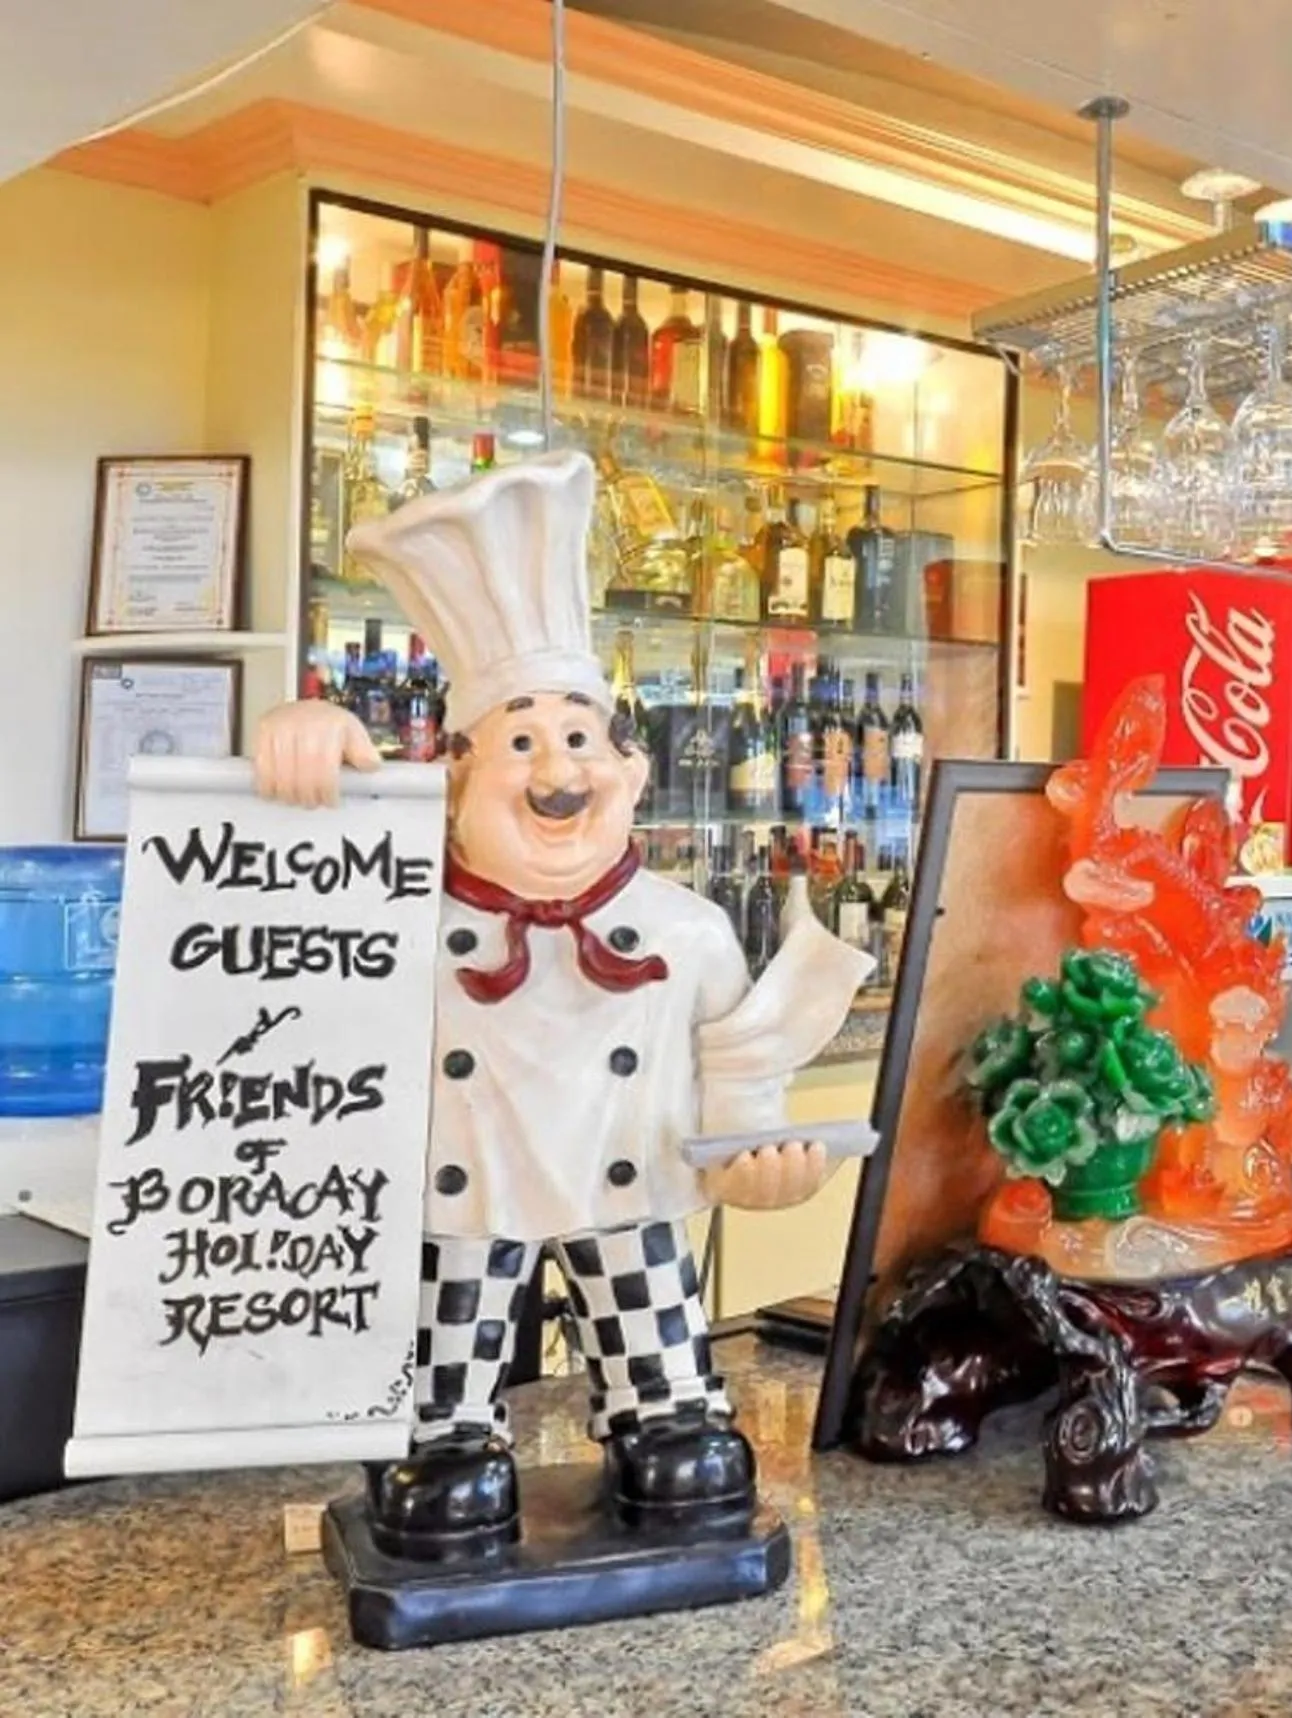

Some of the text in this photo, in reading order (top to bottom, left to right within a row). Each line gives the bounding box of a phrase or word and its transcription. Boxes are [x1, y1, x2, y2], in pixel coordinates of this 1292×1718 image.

[1182, 588, 1276, 779] Cola
[141, 821, 433, 902] WELCOME
[169, 921, 399, 981] GUESTS
[124, 1053, 388, 1147] FRIENDS
[234, 1138, 288, 1175] OF
[106, 1164, 390, 1236] BORACAY
[158, 1224, 380, 1284] HOLIDAY
[158, 1282, 381, 1358] RESORT
